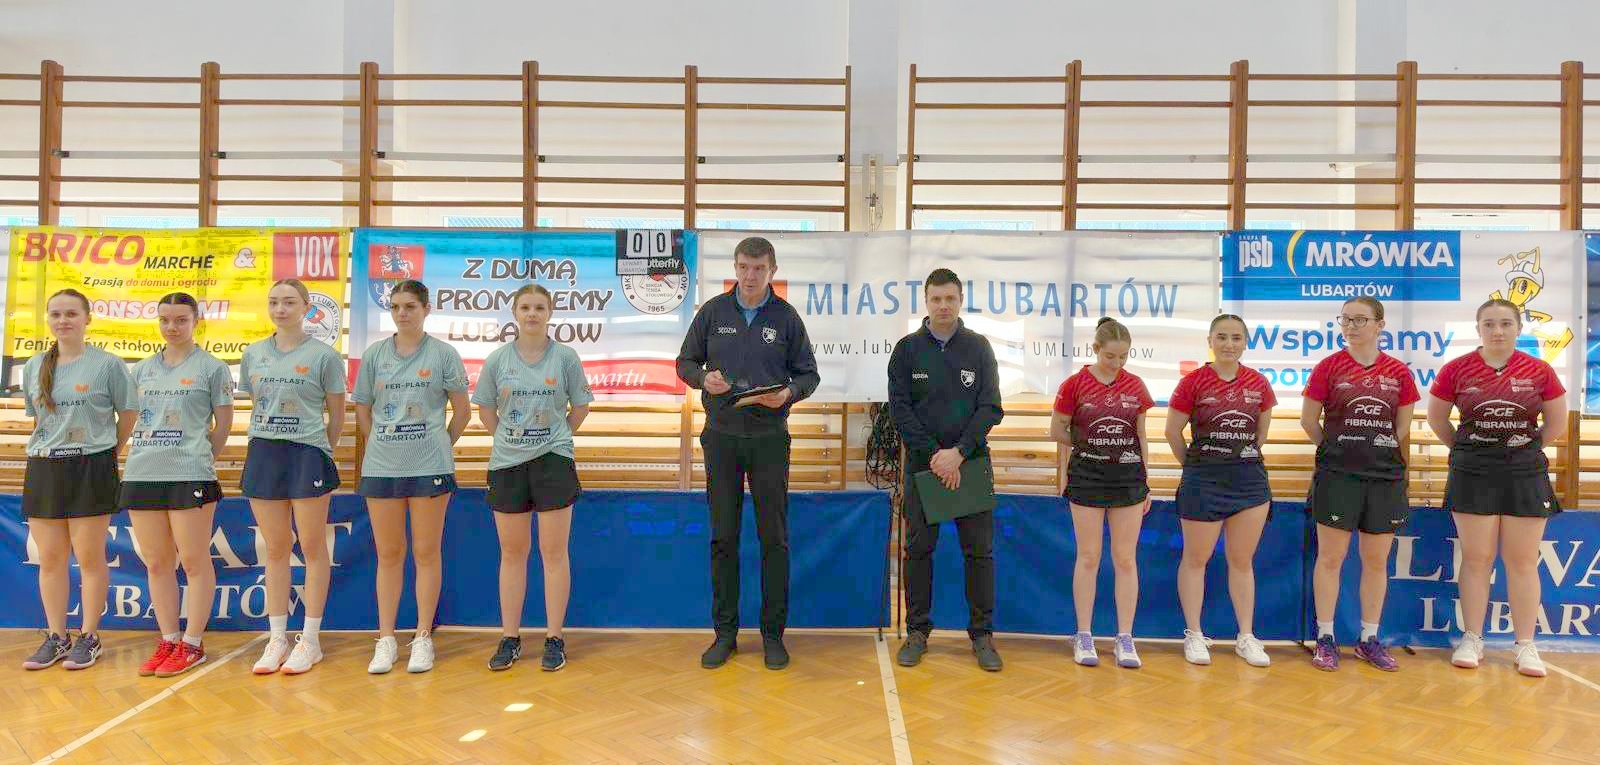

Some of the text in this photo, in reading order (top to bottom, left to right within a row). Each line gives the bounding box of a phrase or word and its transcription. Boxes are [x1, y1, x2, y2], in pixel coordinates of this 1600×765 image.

[633, 232, 666, 253] 0 0
[22, 233, 256, 270] BRICO MARCHÉ &
[293, 236, 338, 277] VOX
[1239, 234, 1454, 272] psb MRÓWKA
[462, 259, 577, 286] Z DUMĄ
[83, 276, 217, 288] Z pasją do domu i ogrodu
[1301, 282, 1394, 297] LUBARTÓW
[436, 288, 613, 311] PROMEMY
[806, 277, 1178, 318] MIAST LUBARTÓW
[1354, 404, 1383, 415] PGE
[1483, 407, 1515, 417] PGE
[1220, 419, 1248, 428] PGE
[1345, 418, 1383, 428] FIBRAIN
[1475, 421, 1516, 429] FIBRAIN
[1097, 425, 1125, 434] PGE
[1088, 438, 1126, 446] FIBRAIN
[1210, 432, 1248, 440] FIBRAIN
